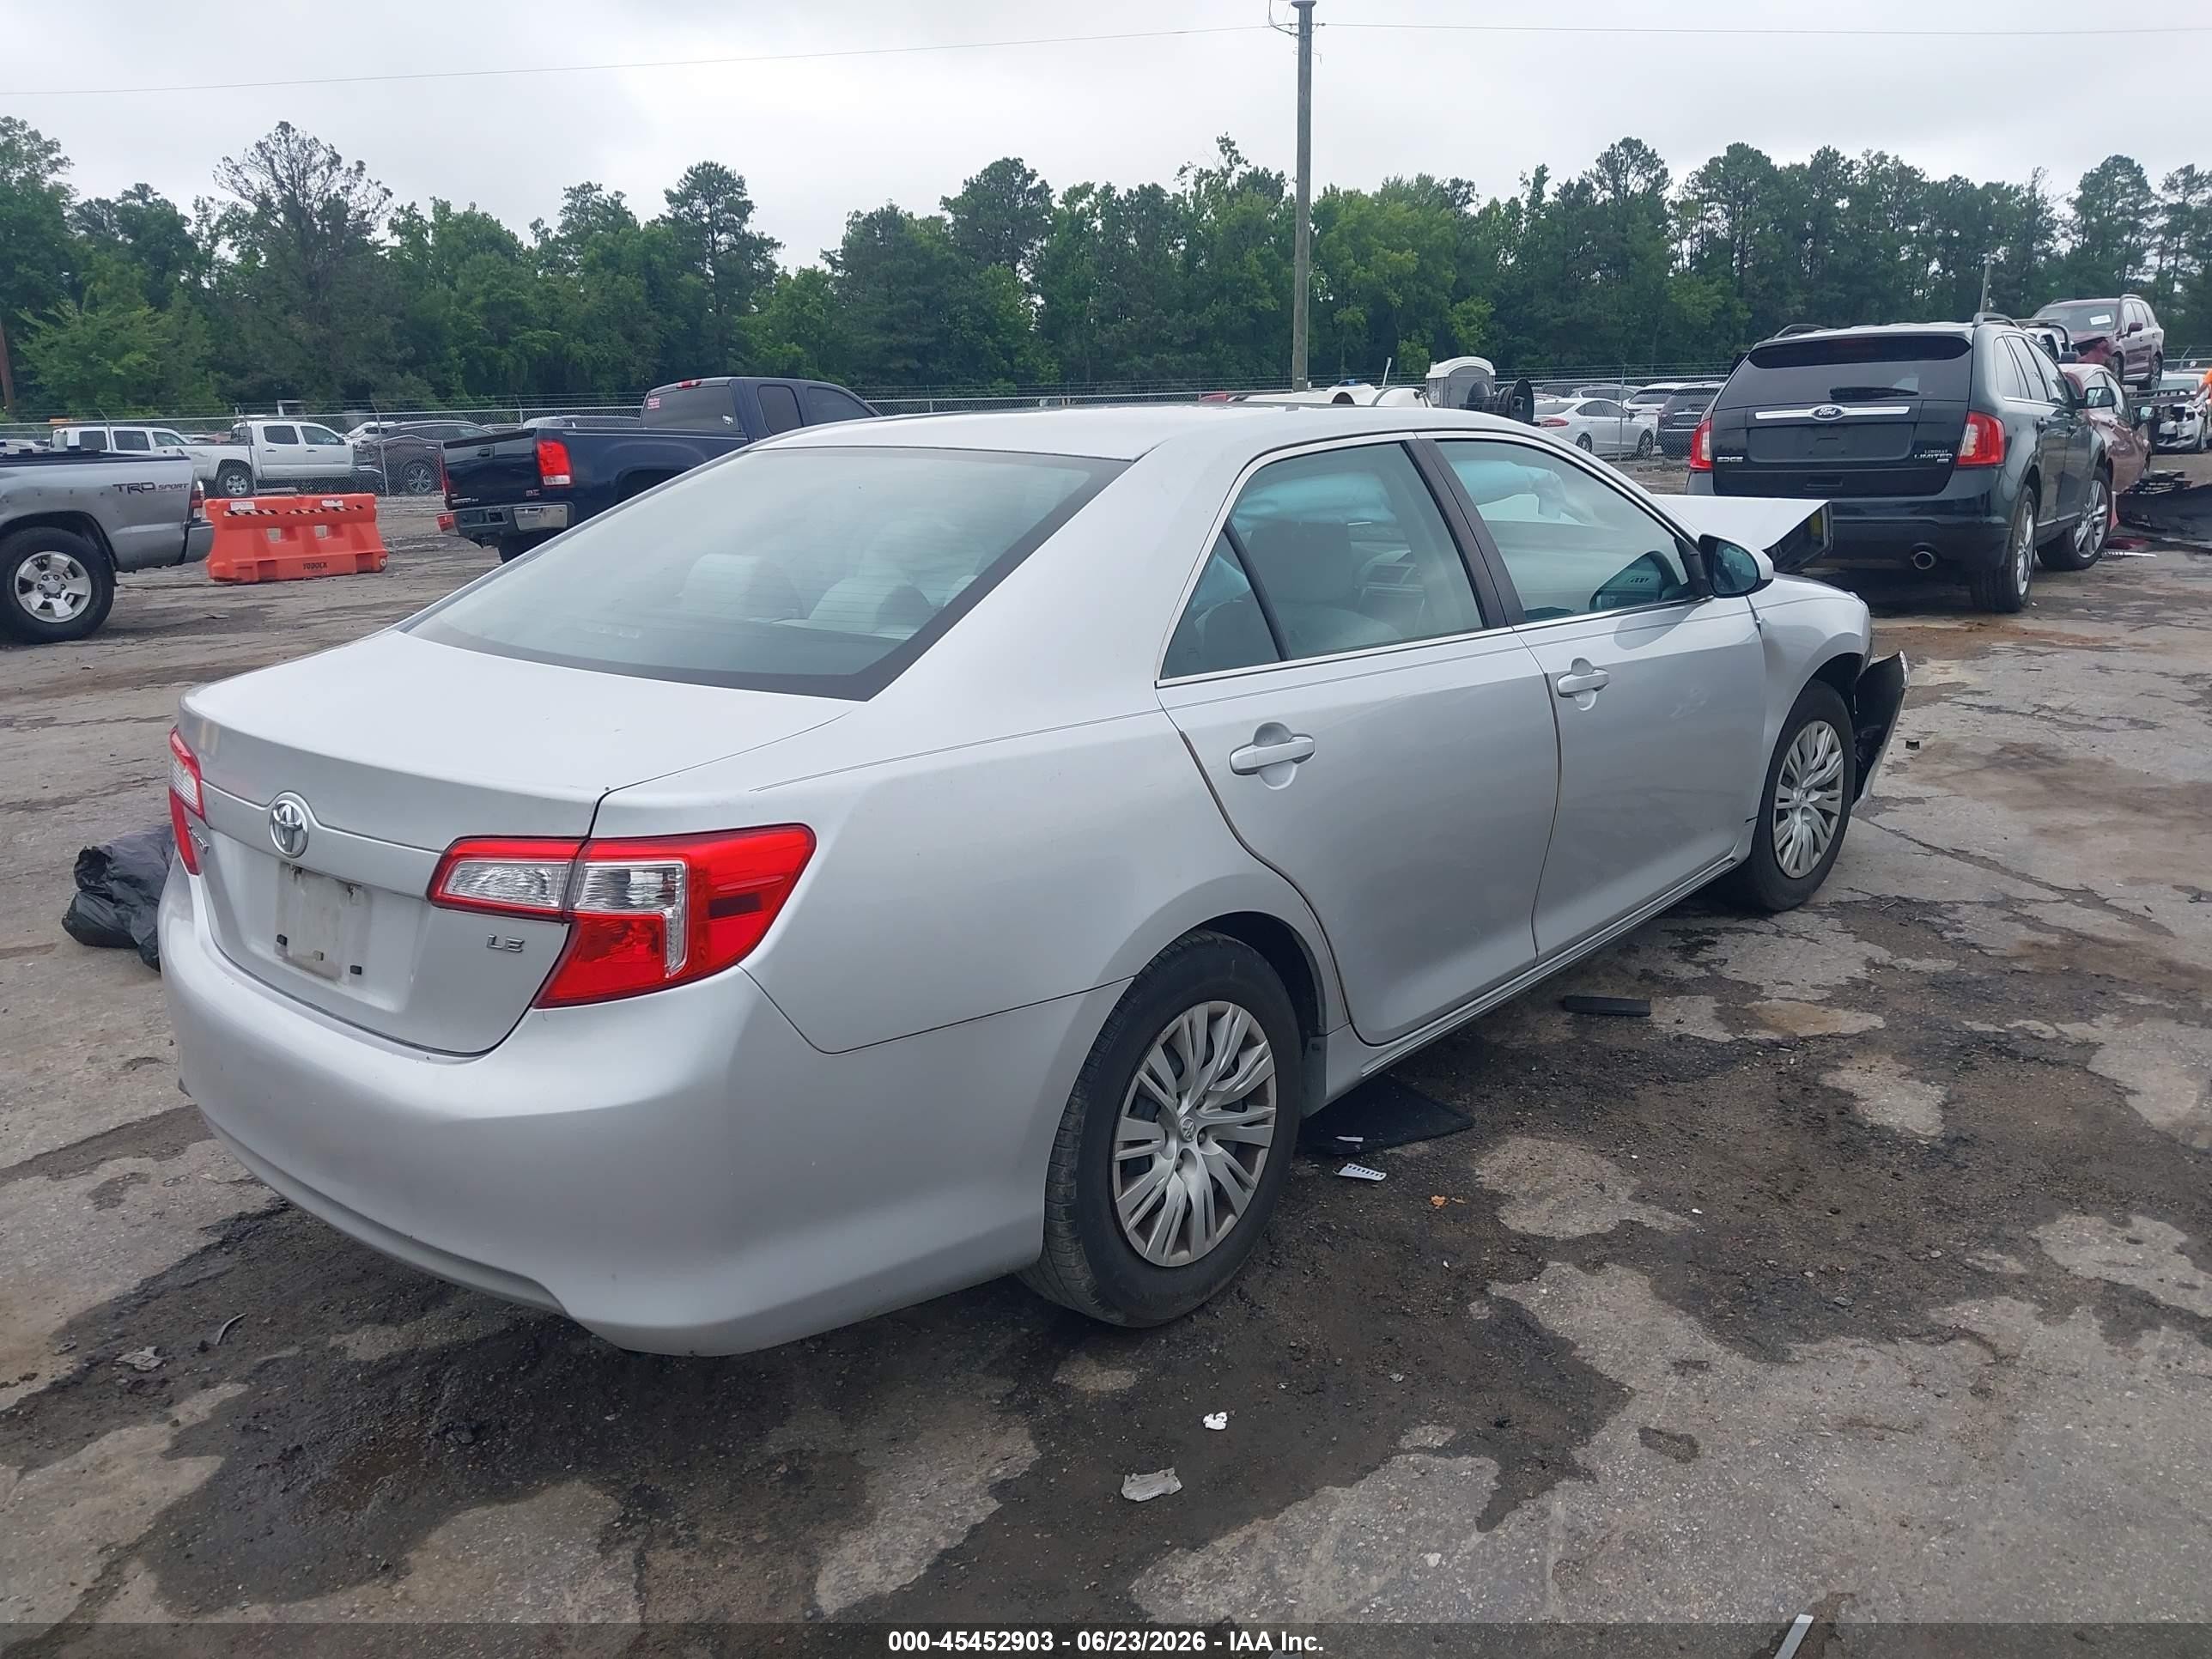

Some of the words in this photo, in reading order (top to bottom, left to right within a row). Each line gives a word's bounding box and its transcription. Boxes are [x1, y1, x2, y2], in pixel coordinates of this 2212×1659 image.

[1818, 406, 1838, 416] Ford
[112, 481, 156, 495] TRD
[486, 934, 525, 953] LE
